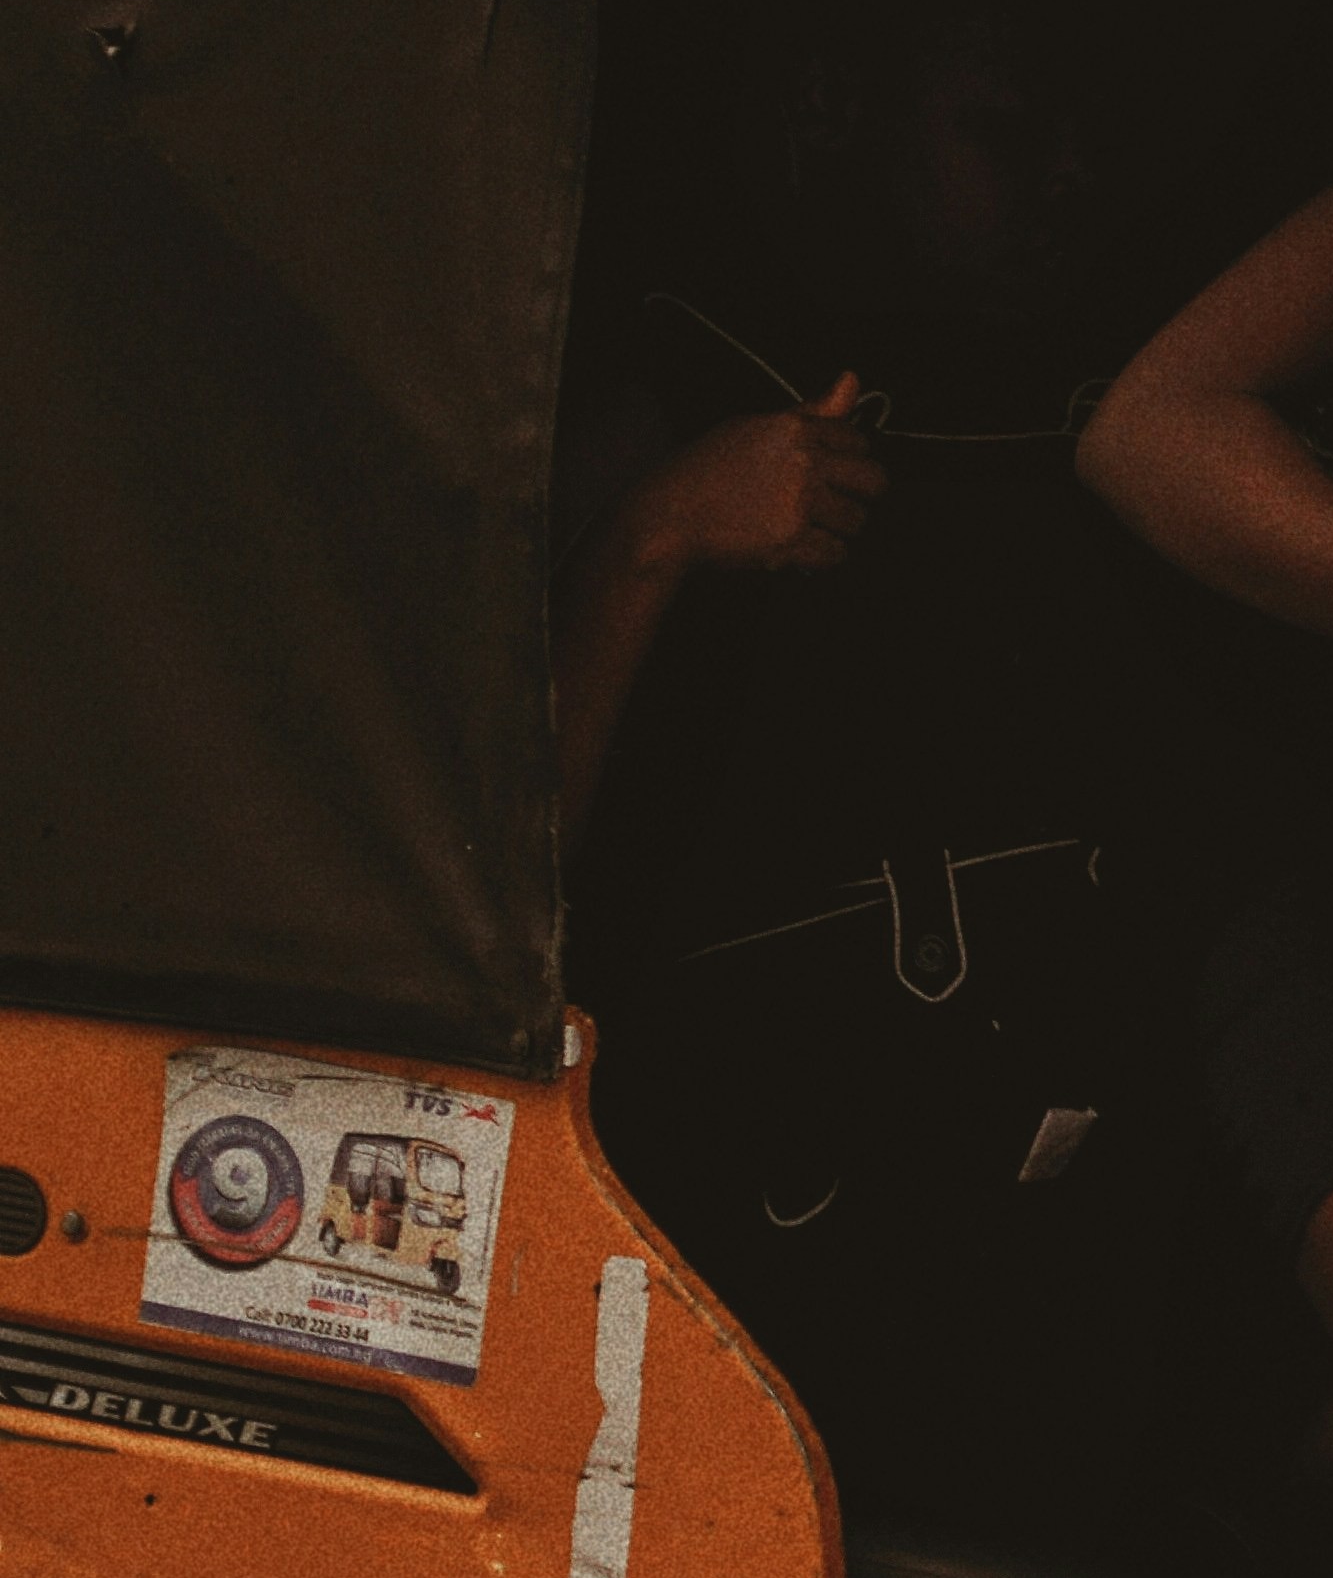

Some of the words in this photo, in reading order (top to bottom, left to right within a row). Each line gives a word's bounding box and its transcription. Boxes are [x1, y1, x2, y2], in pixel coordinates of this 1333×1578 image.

[403, 1090, 454, 1117] TVS
[309, 1317, 333, 1335] 222
[335, 1323, 351, 1339] 33
[49, 1383, 278, 1449] DELUXE
